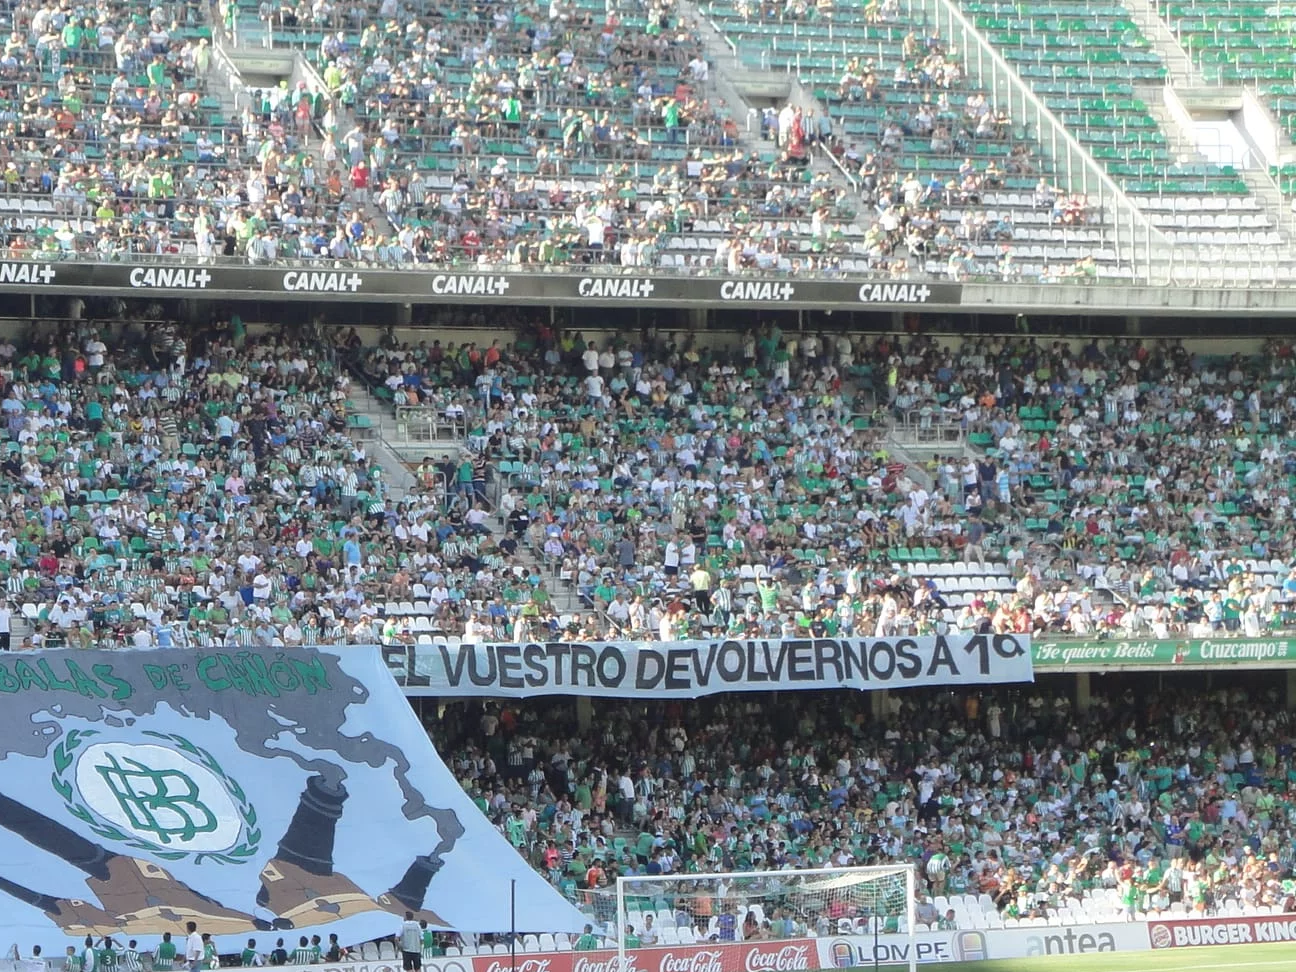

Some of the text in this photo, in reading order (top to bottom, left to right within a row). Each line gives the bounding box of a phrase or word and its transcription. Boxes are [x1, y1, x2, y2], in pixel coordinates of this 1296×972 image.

[129, 267, 212, 289] CANAL+
[283, 271, 363, 293] CANAL+
[431, 275, 510, 296] CANAL+
[578, 277, 654, 299] CANAL+
[720, 280, 795, 302] CANAL+
[859, 284, 931, 303] CANAL+
[1200, 640, 1276, 661] Cruzcampo
[383, 645, 432, 687] EL
[445, 644, 625, 689] VUESTRO
[635, 638, 921, 690] DEVOLVERNOS
[927, 642, 959, 677] A
[149, 662, 189, 692] DE
[1025, 927, 1116, 957] antea
[1173, 923, 1253, 946] BURGER
[745, 945, 809, 972] Coca-Cola
